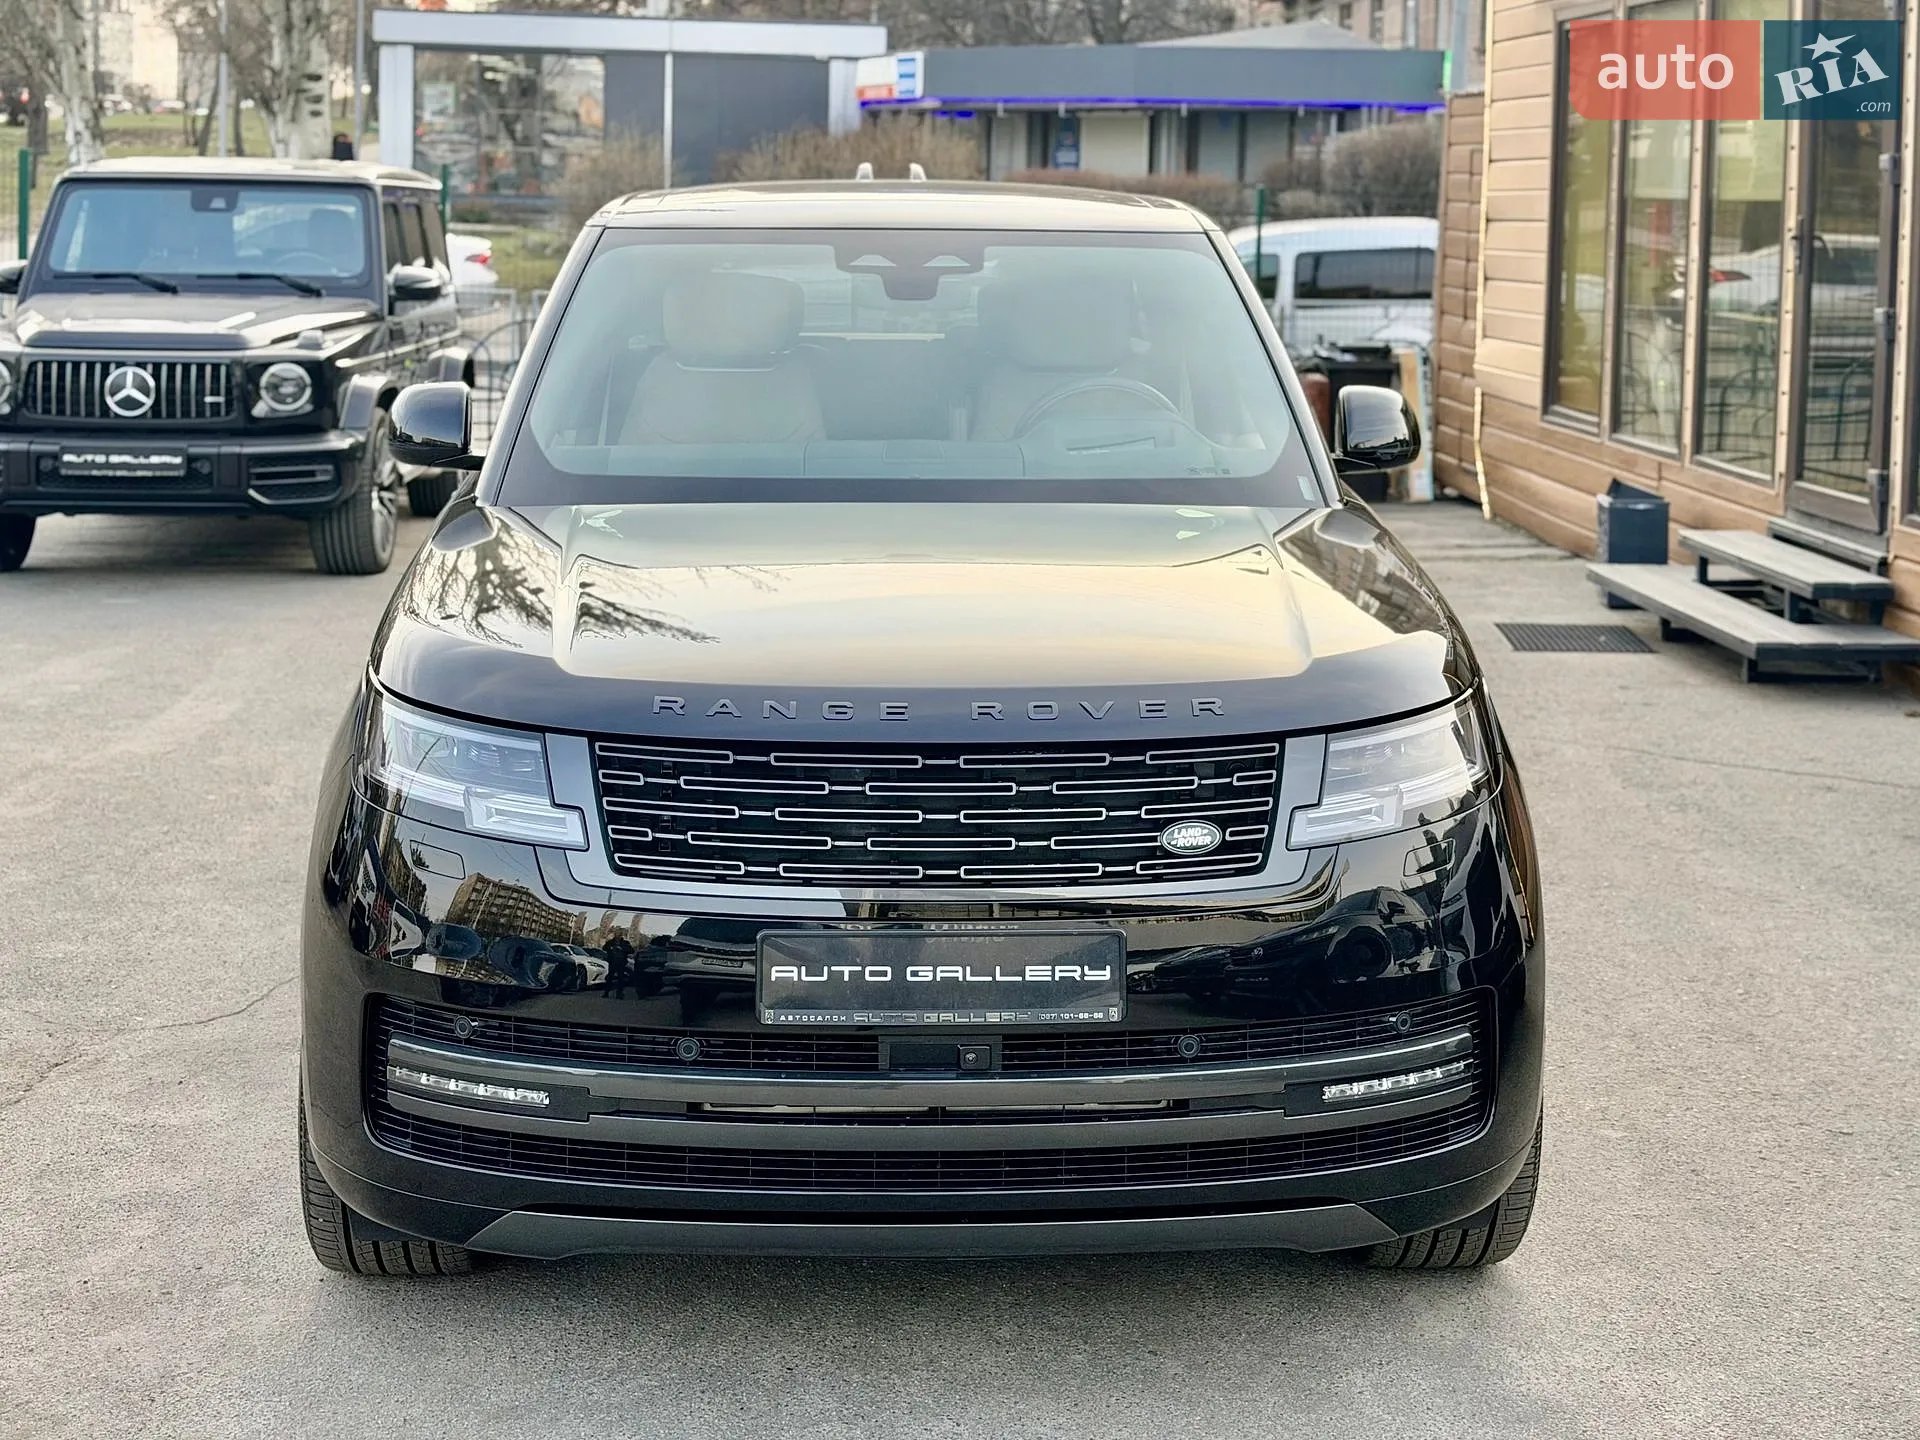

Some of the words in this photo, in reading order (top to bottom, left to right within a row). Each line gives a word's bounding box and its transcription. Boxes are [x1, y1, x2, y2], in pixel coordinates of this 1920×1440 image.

[62, 453, 107, 463] AUTO
[108, 454, 183, 464] GALLERY
[652, 695, 910, 721] RANGE
[970, 697, 1226, 720] ROVER
[1173, 827, 1202, 838] LAND
[1176, 835, 1212, 847] ROVER
[771, 965, 892, 981] AUTO
[906, 965, 1111, 981] GALLERY
